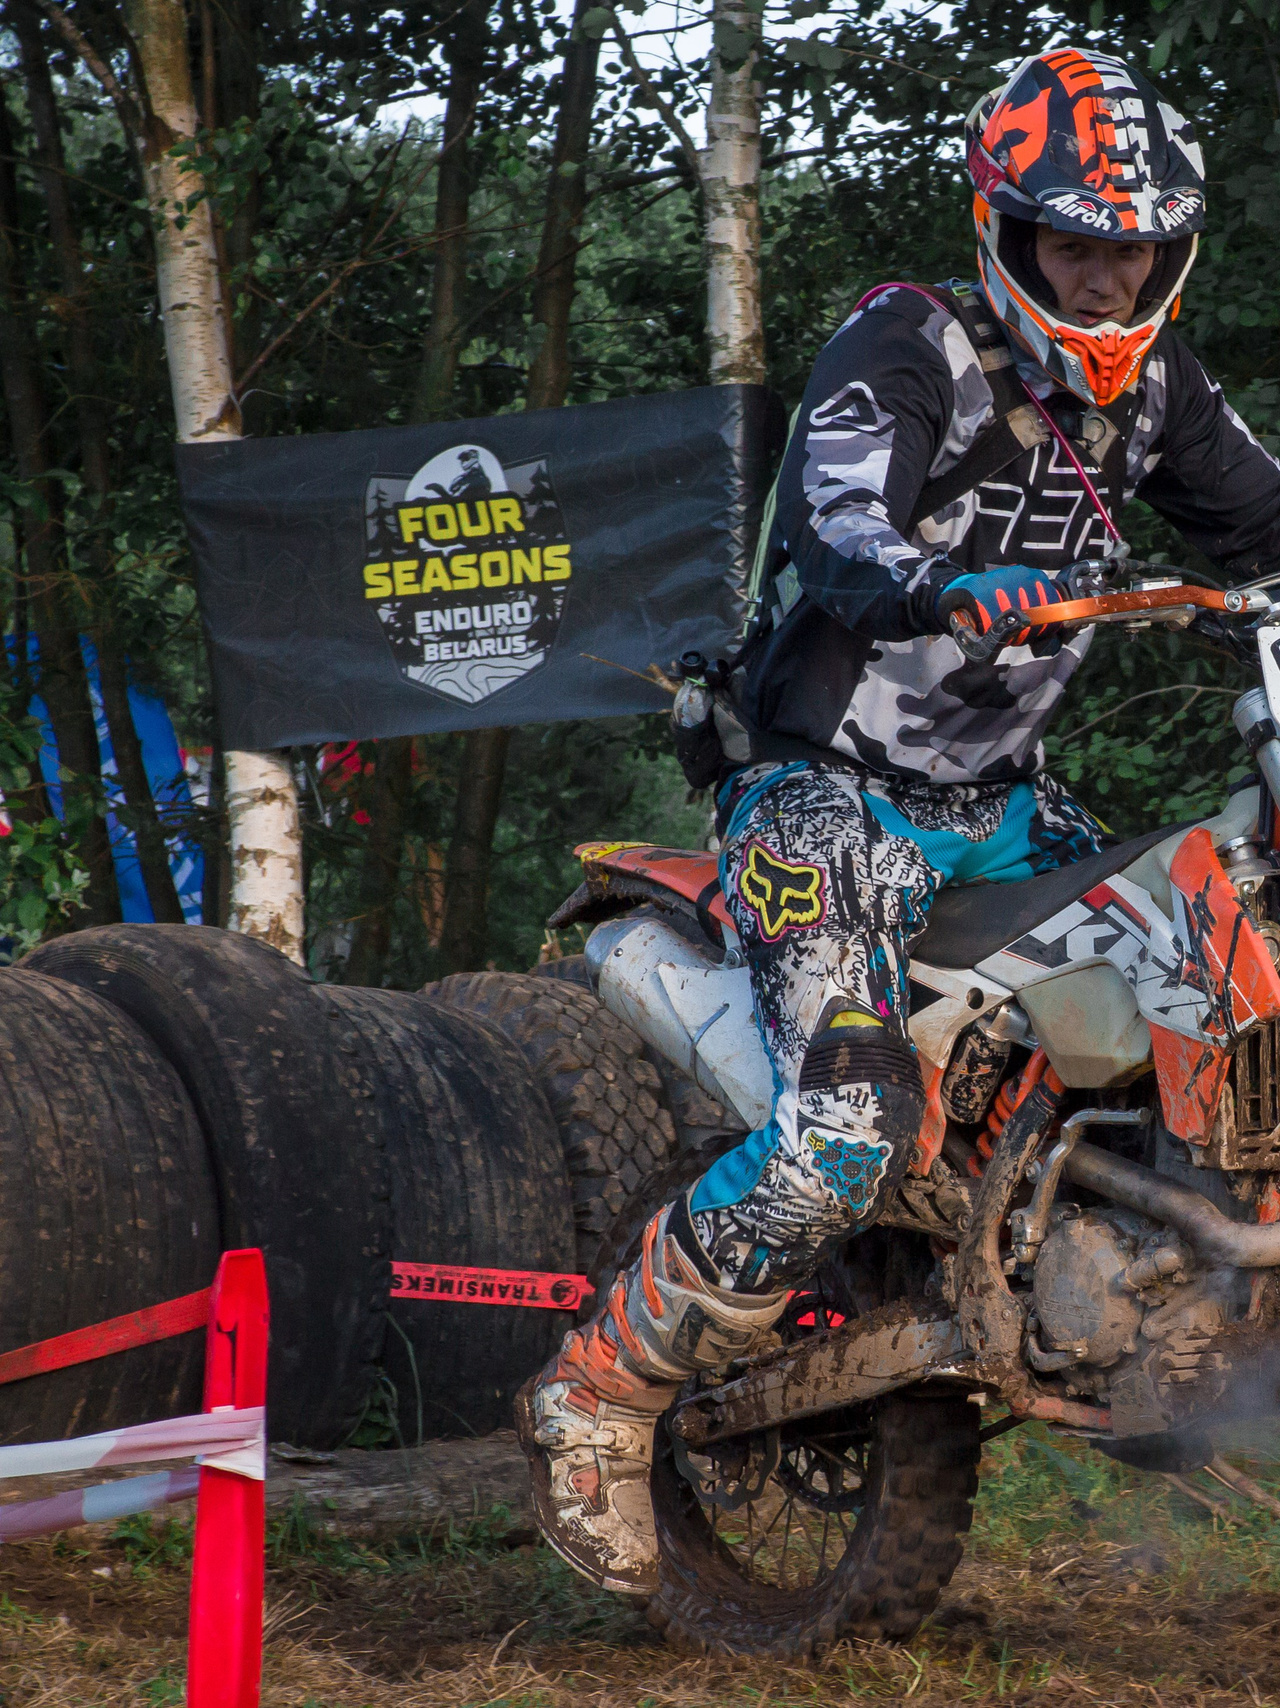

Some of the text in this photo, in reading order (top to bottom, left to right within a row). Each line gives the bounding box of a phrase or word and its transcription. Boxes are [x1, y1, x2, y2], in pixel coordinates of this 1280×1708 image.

[1044, 193, 1112, 231] Airoh
[1157, 193, 1201, 232] Airoh
[398, 498, 525, 543] FOUR
[363, 544, 572, 599] SEASONS
[414, 601, 532, 633] ENDURO
[424, 635, 527, 661] BELARUS
[390, 1272, 541, 1301] TRANSIMEKS
